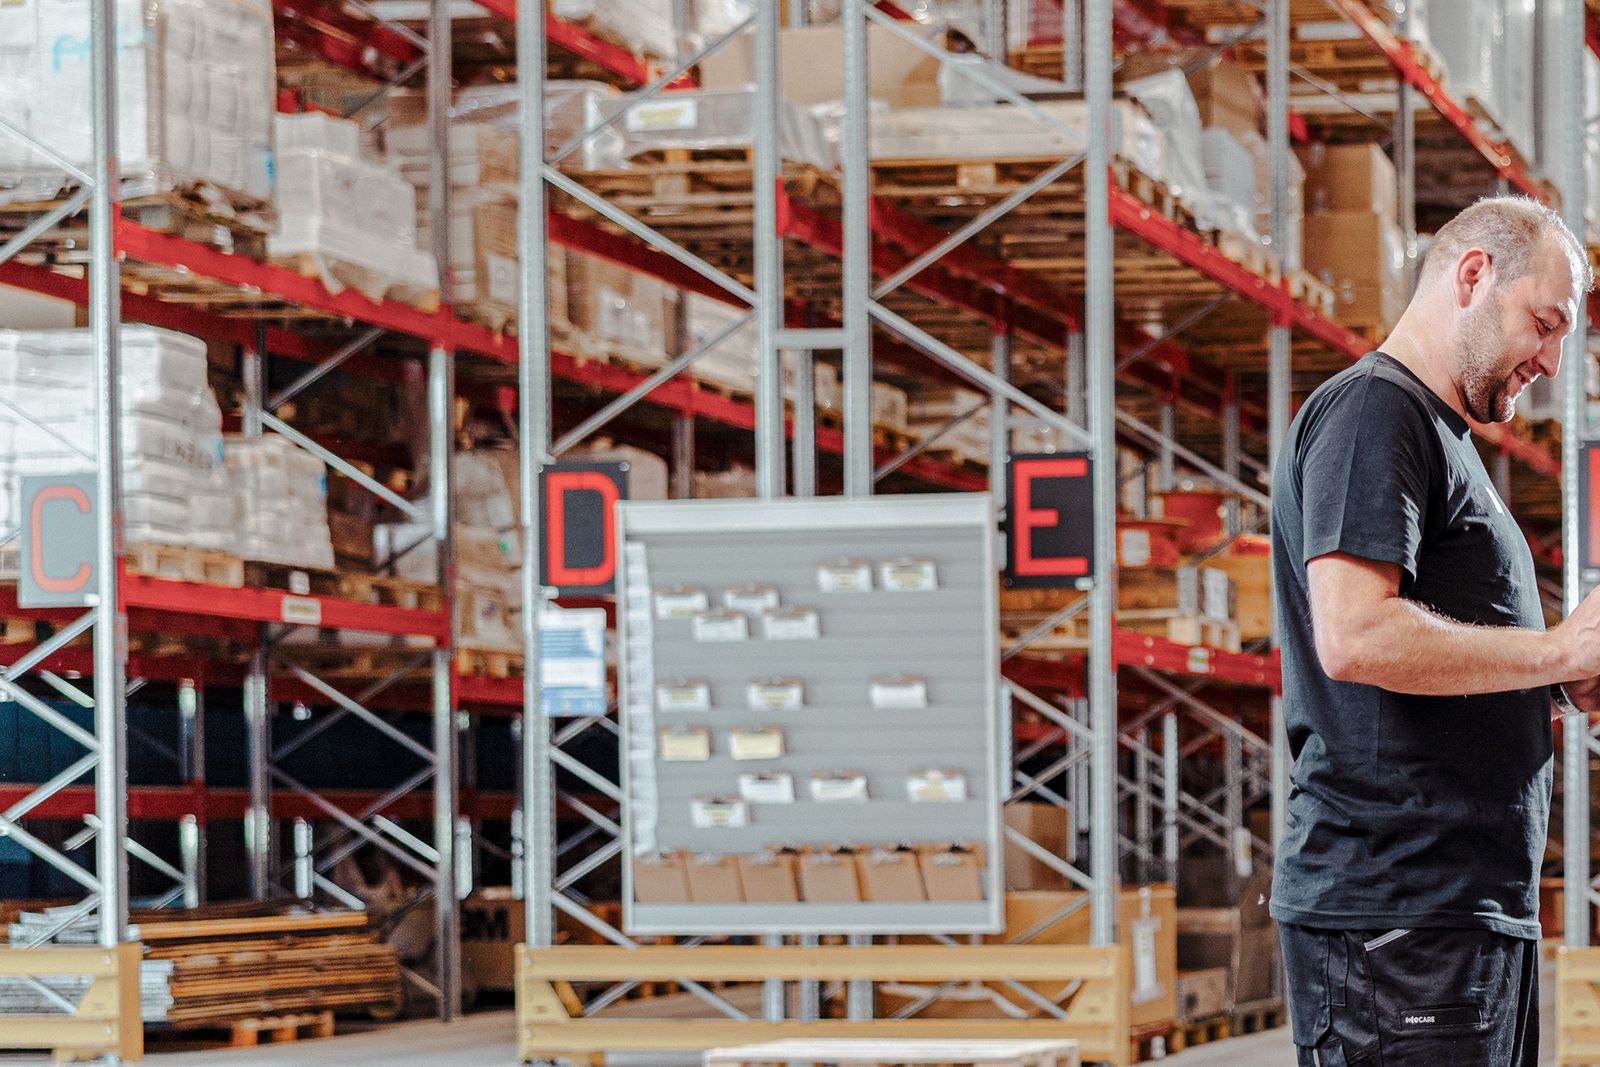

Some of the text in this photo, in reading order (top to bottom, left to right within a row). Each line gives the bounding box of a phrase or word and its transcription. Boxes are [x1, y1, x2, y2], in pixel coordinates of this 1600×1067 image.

[30, 484, 92, 593] C
[546, 471, 619, 586] D
[1013, 458, 1088, 576] E
